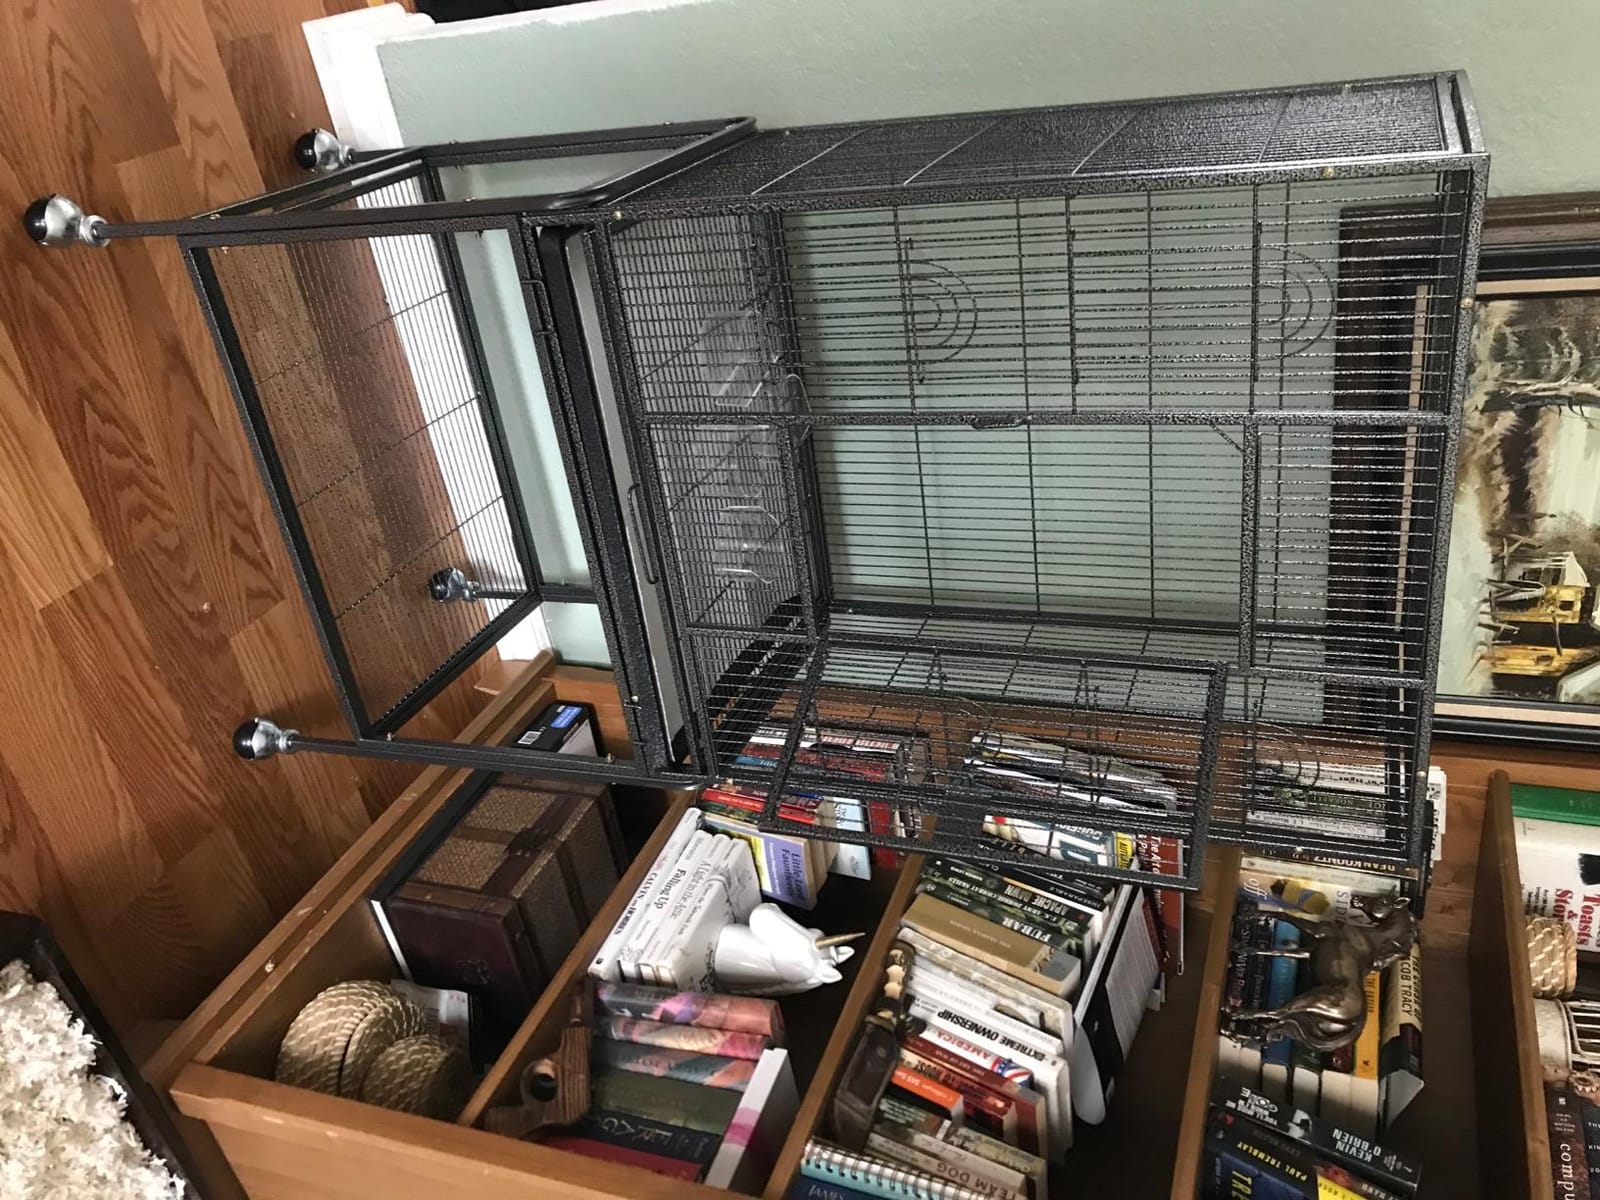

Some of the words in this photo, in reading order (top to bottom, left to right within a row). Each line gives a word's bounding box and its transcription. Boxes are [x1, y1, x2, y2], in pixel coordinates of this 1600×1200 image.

[792, 852, 801, 878] Little
[636, 871, 658, 901] CALVIN
[659, 866, 686, 898] Falling
[1004, 884, 1032, 902] DAWN
[652, 895, 669, 910] Up
[1032, 894, 1070, 916] APACHE
[1568, 910, 1578, 922] &
[1001, 916, 1052, 943] FUBAR
[1576, 894, 1600, 946] Toasts
[1400, 984, 1413, 1017] TRACY
[937, 1008, 999, 1042] OWNERSHIP
[999, 1035, 1045, 1062] EXTREME
[1236, 1140, 1282, 1168] TREMBLAY
[1332, 1128, 1382, 1156] O'BRIEN
[1336, 1140, 1372, 1163] KEVIN
[935, 1161, 971, 1183] DOG
[1284, 1163, 1308, 1182] PAUL
[1558, 1143, 1576, 1200] compu
